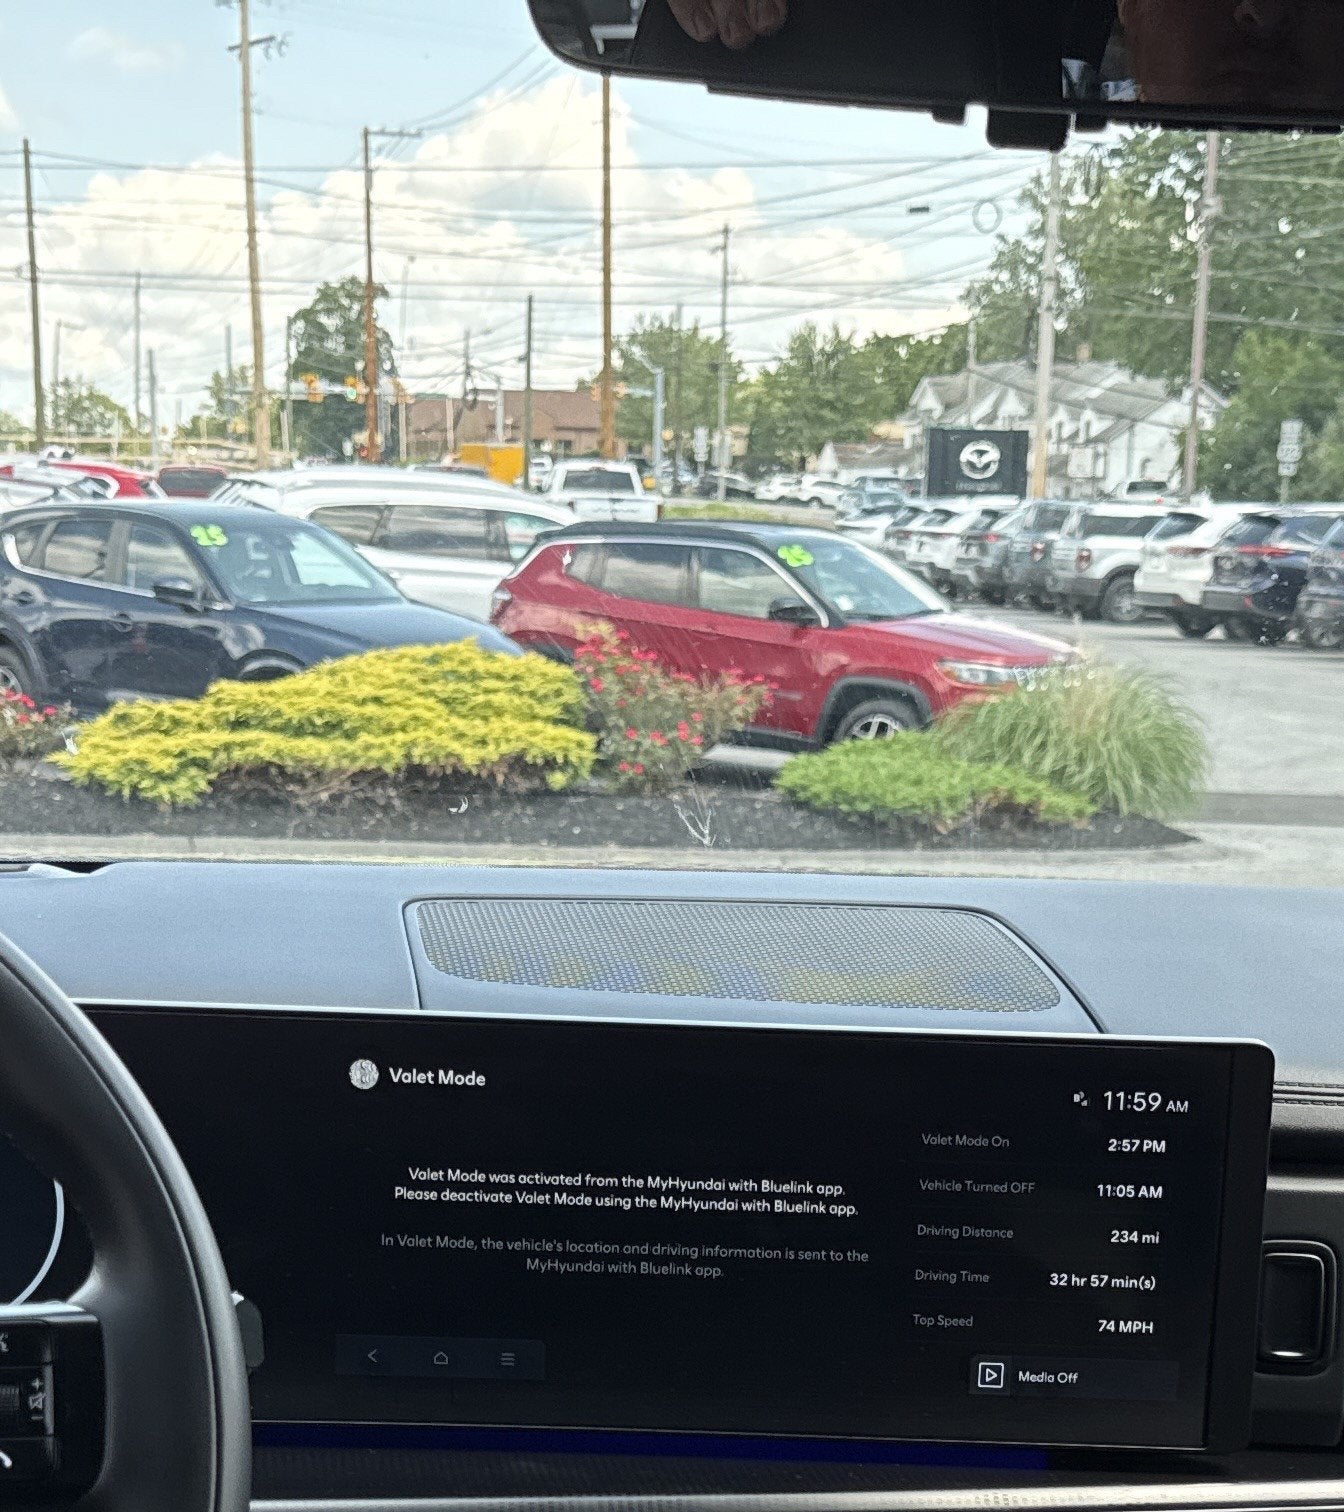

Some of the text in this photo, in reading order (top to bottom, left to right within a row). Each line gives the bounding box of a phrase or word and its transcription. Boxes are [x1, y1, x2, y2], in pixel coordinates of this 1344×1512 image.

[389, 1068, 486, 1086] Valet Mode
[1103, 1091, 1189, 1113] 11:59 AM
[921, 1133, 1010, 1148] Valet Mode On
[1107, 1139, 1166, 1153] 2:57 PM
[409, 1167, 846, 1197] Valet Mode was activated from the MyHyundai with Bluelink app.
[919, 1179, 1036, 1193] Vehicle Turned OFF
[1097, 1184, 1163, 1199] 11:05 AM
[395, 1187, 859, 1217] Please deactivate Valet Mode using the MyHyundai with Bluelink app.
[917, 1224, 1014, 1240] Driving Distance
[1110, 1230, 1160, 1245] 234 mi
[381, 1234, 869, 1262] In Valet Mode, the vehicle's location and driving information is sent to the
[526, 1258, 724, 1279] MyHyundai with Bluelink app.
[915, 1269, 989, 1284] Driving Time
[1049, 1273, 1156, 1290] 32 hr 57 min(s)
[913, 1314, 974, 1329] Top Speed
[1098, 1320, 1154, 1334] 74 MPH
[1018, 1371, 1079, 1384] Media Off
